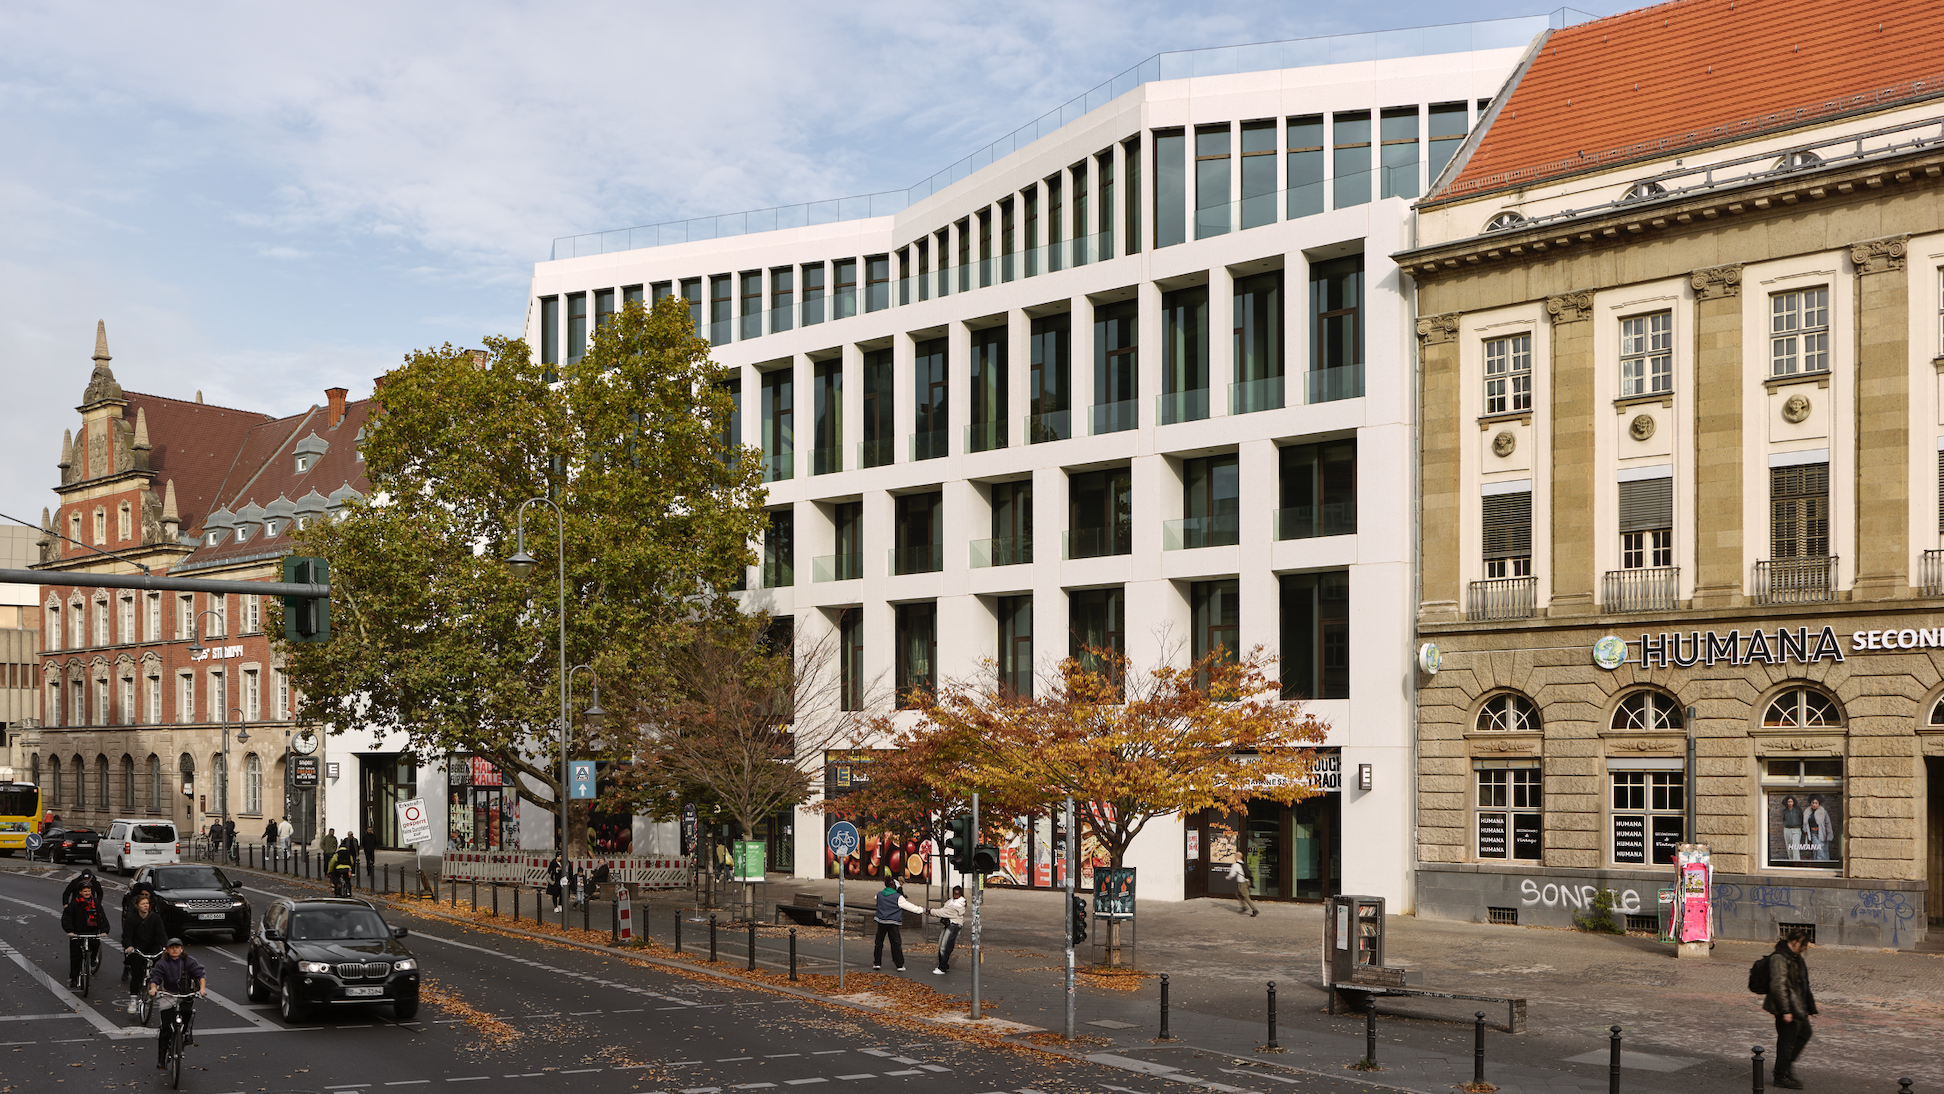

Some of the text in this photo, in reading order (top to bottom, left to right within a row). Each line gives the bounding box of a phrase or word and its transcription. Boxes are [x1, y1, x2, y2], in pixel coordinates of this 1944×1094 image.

[1852, 628, 1944, 651] SECON
[1641, 627, 1845, 669] HUMANA
[474, 775, 502, 785] KALLE
[451, 804, 473, 813] KALLE
[403, 819, 426, 828] gesperrt
